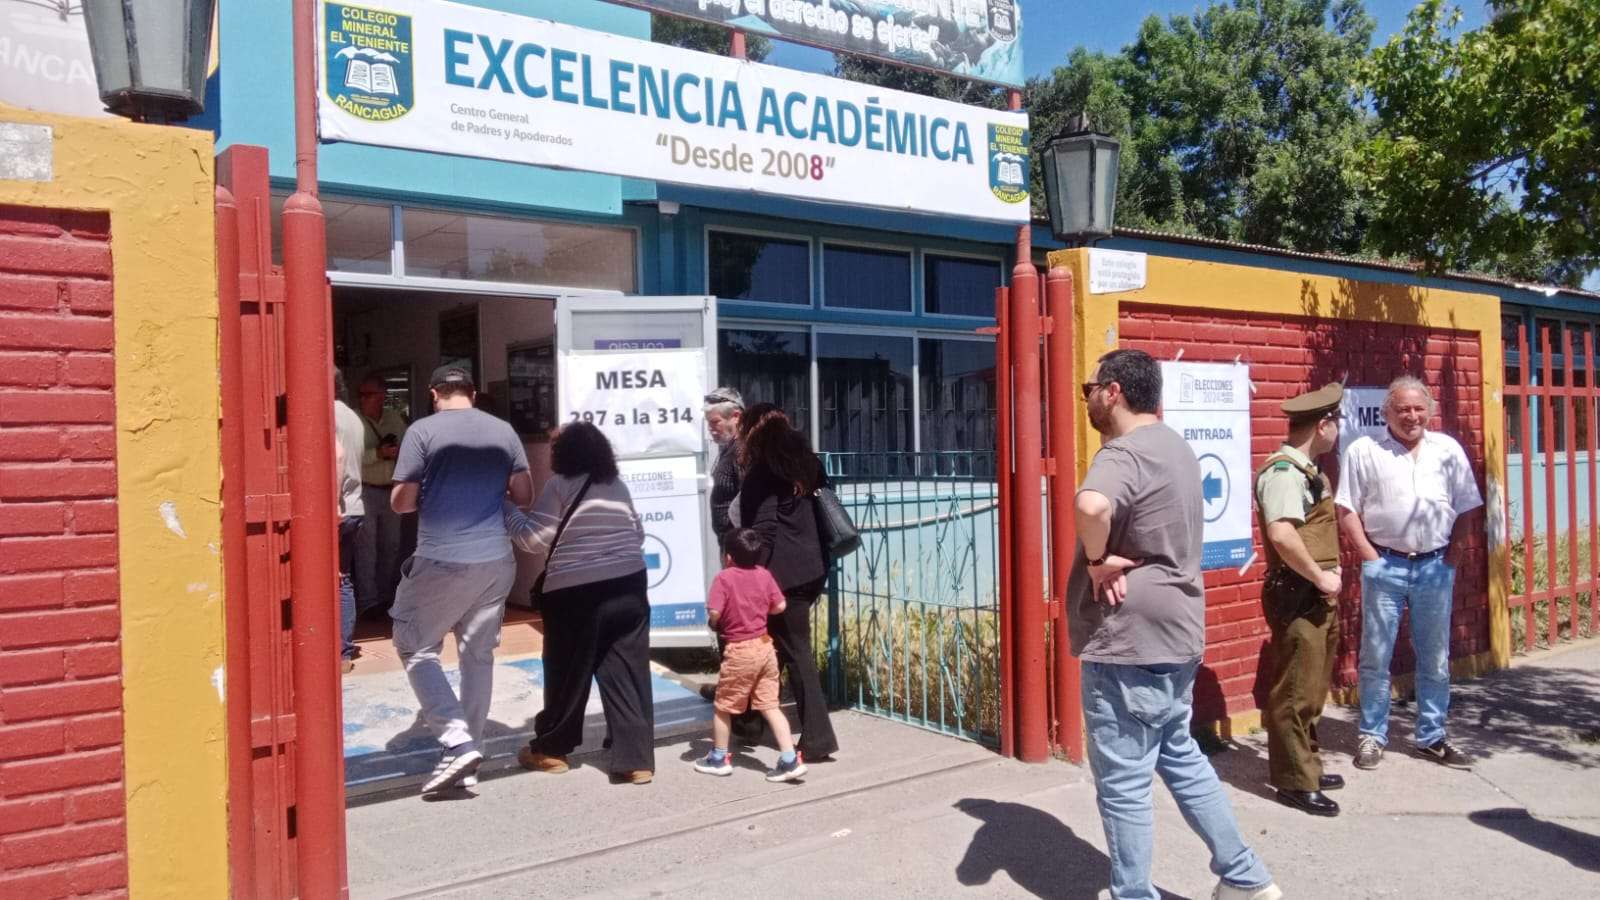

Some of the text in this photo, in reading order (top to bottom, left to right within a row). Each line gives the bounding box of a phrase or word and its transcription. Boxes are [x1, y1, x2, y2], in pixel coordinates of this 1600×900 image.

[341, 7, 398, 26] COLEGIO
[342, 20, 398, 39] MINERAL
[330, 31, 409, 53] EL TENIENTE
[335, 94, 408, 120] RANCAGUA
[443, 28, 975, 165] EXCELENCIA ACADÉMICA
[450, 103, 529, 124] Centro General
[450, 120, 573, 146] de Padres y Apoderados
[596, 369, 667, 390] MESA
[1194, 379, 1233, 391] ELECCIONES
[614, 413, 626, 425] a
[632, 408, 650, 424] la
[657, 407, 694, 424] 314
[1183, 428, 1233, 440] ENTRADA
